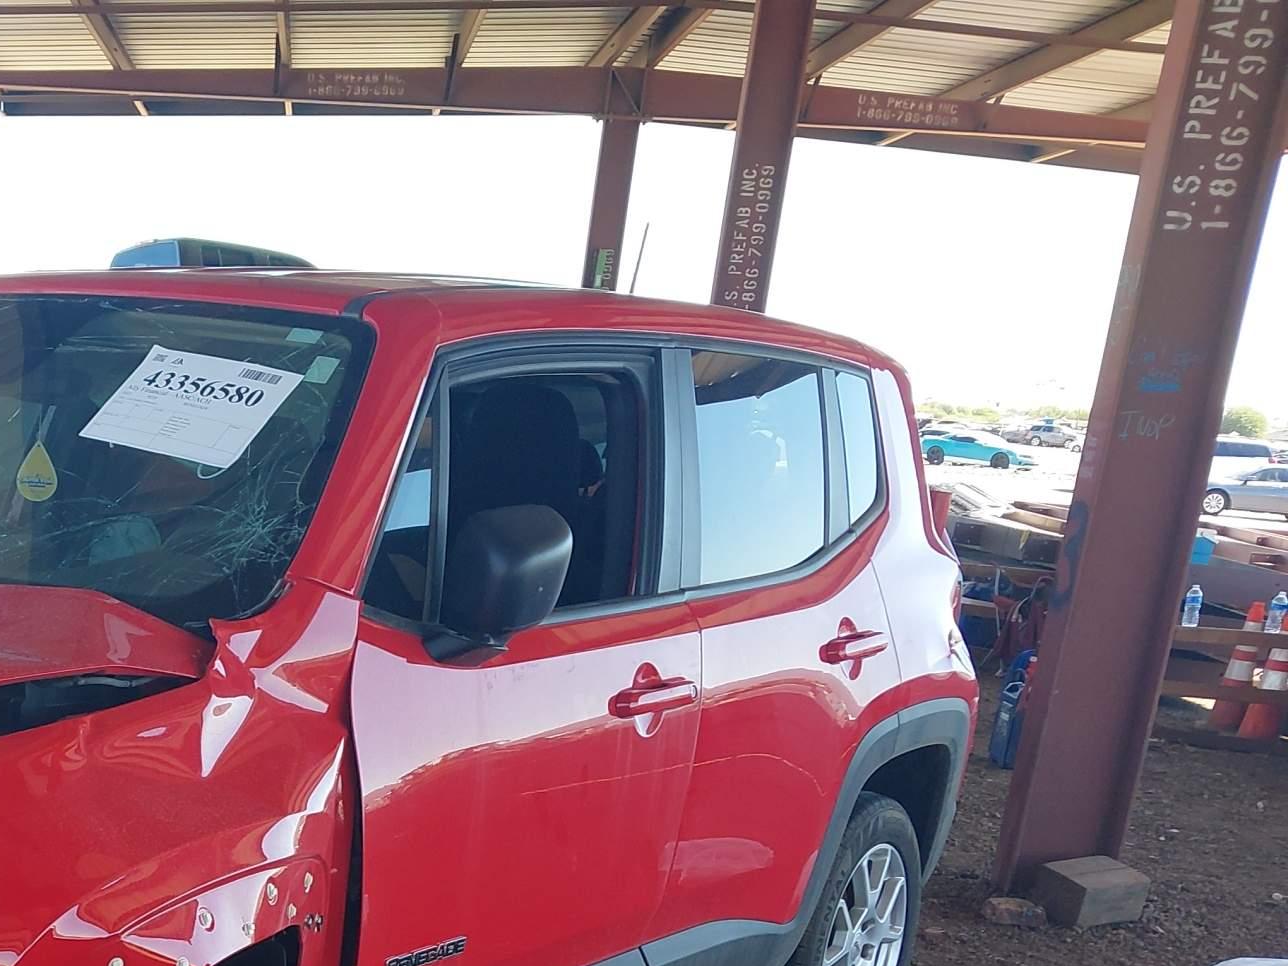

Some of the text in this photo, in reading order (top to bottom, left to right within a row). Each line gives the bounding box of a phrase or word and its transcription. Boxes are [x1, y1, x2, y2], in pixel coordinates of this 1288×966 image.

[1183, 0, 1244, 140] PREFAB
[1199, 0, 1282, 230] 1-866-799-
[727, 207, 752, 275] PREFAB
[741, 165, 776, 311] -866-799-0969
[143, 370, 265, 407] 43356580
